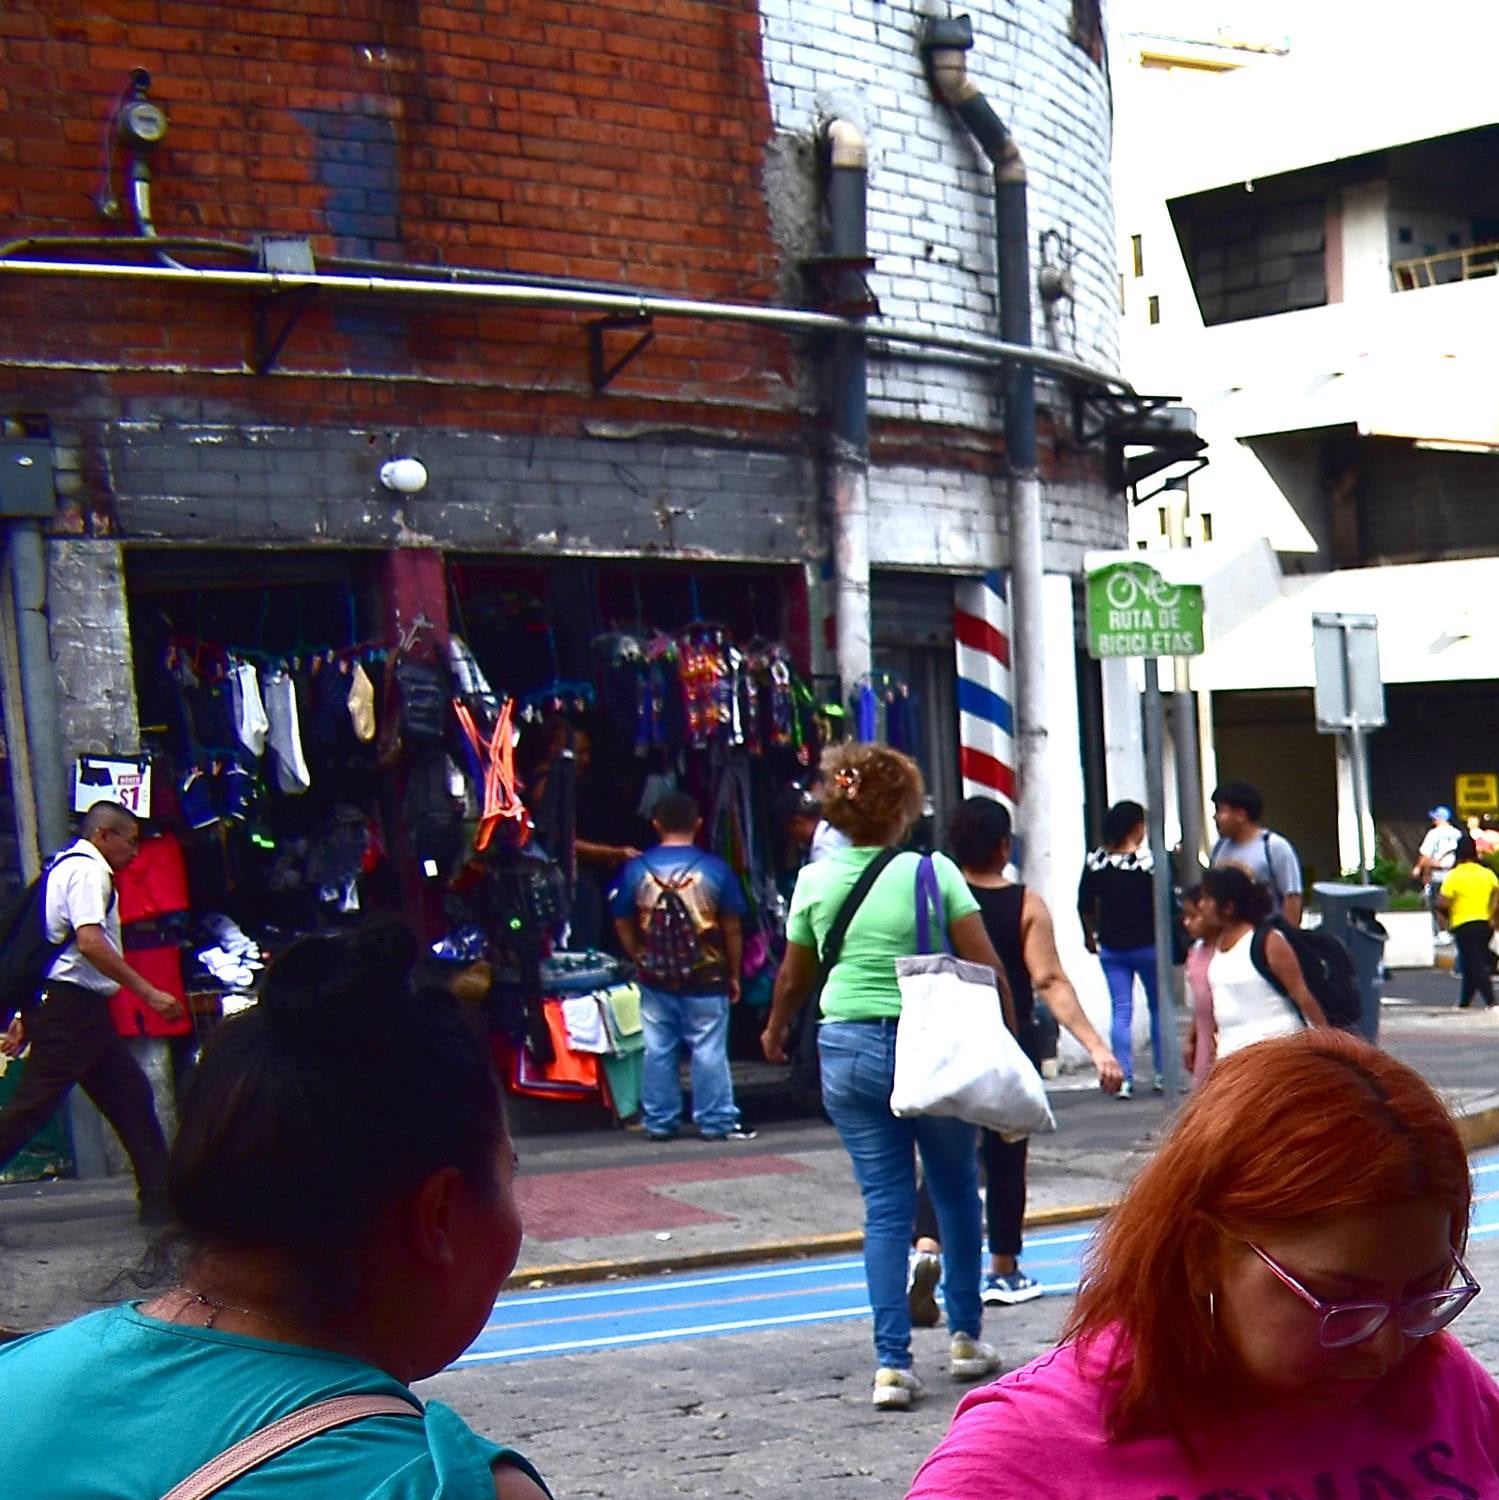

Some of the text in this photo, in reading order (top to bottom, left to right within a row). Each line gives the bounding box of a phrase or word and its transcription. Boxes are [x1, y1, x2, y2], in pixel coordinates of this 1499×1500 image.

[1108, 607, 1182, 630] RUTA DE
[1098, 632, 1195, 655] BICICLETAS
